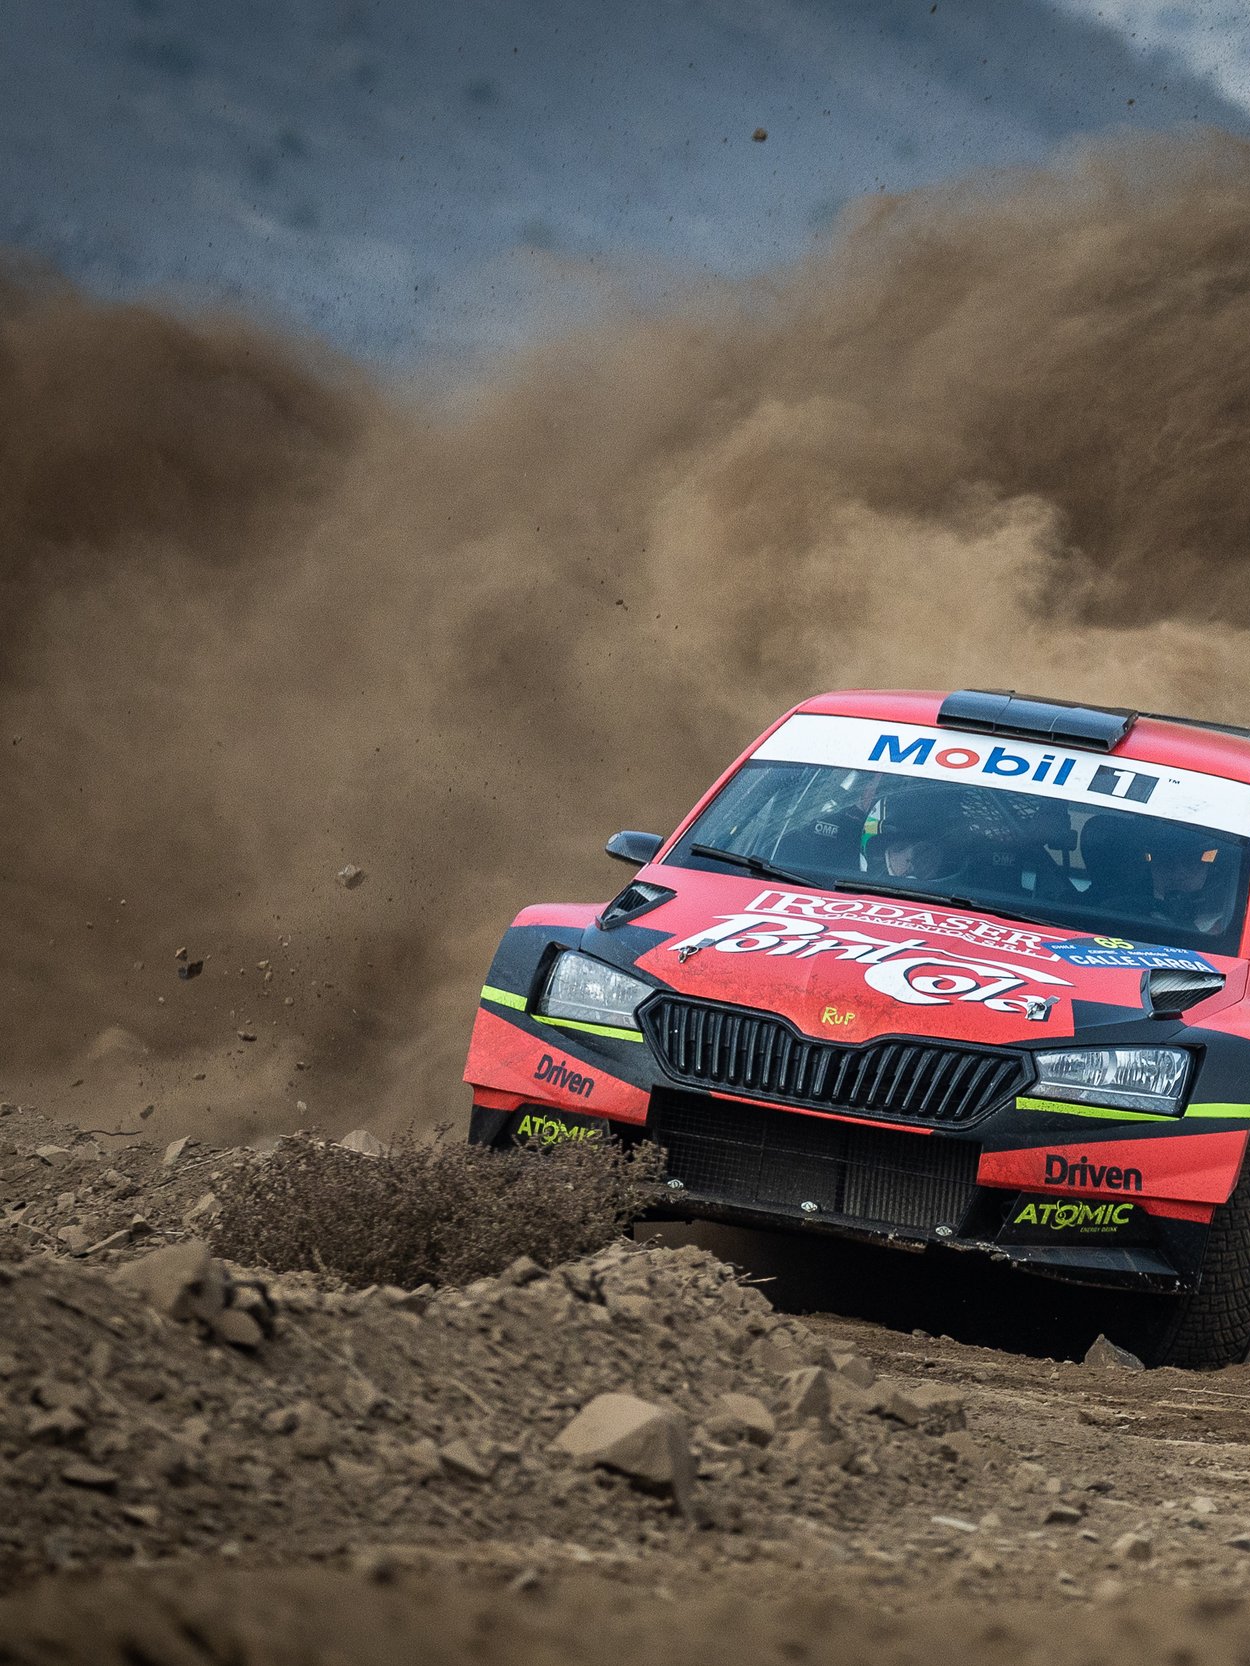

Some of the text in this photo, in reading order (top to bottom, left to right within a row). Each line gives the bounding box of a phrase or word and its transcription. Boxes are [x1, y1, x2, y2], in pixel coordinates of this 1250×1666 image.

[868, 734, 1077, 786] Mobil
[814, 822, 839, 835] OMP
[763, 893, 1042, 950] RODASER
[1093, 936, 1135, 950] 65
[1069, 954, 1214, 973] CALLE LARGA
[533, 1053, 595, 1099] Driven
[1044, 1153, 1143, 1191] Driven
[1013, 1200, 1134, 1229] ATOMIC
